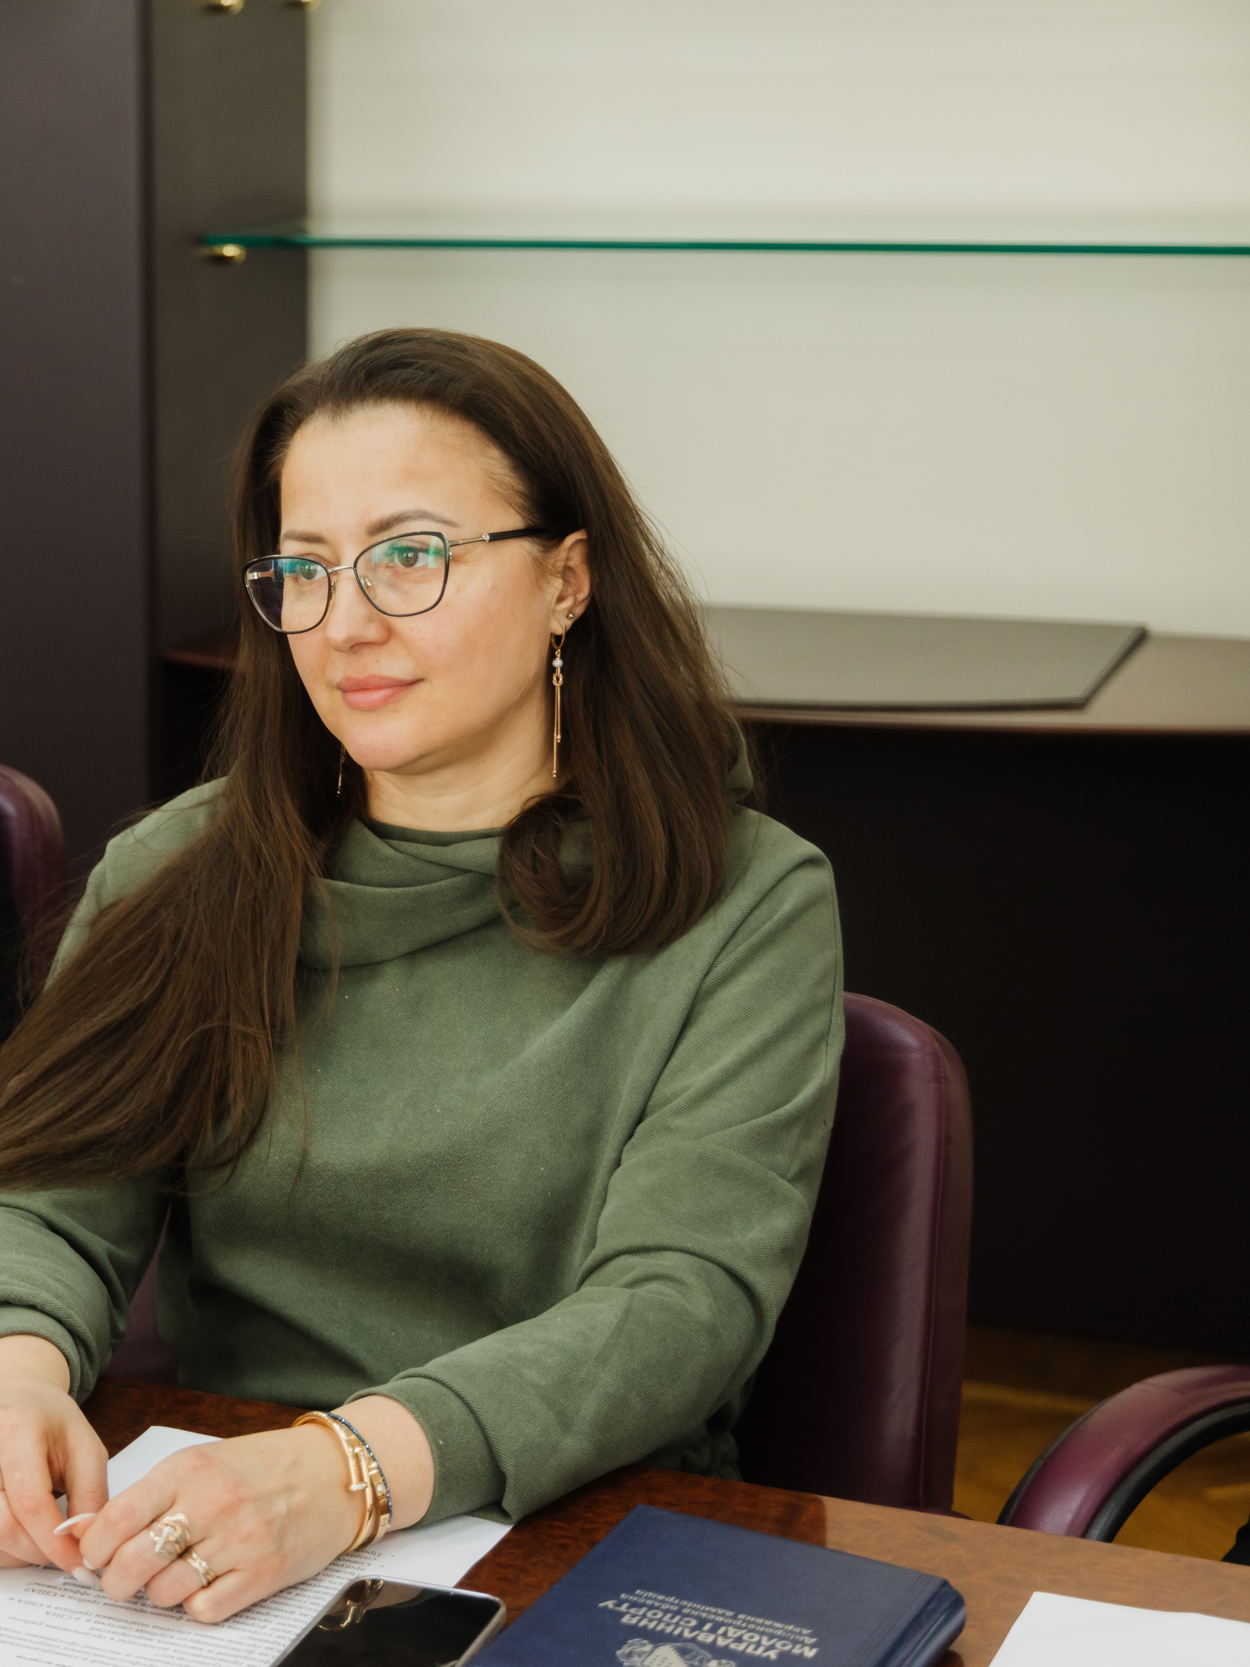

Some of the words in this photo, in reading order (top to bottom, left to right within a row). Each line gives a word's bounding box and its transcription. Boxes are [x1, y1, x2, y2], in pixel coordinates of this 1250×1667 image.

[598, 1599, 699, 1627] СПОРТУ
[619, 1613, 780, 1660] УПРАВЛІННЯ
[716, 1626, 819, 1658] МОЛОДІ
